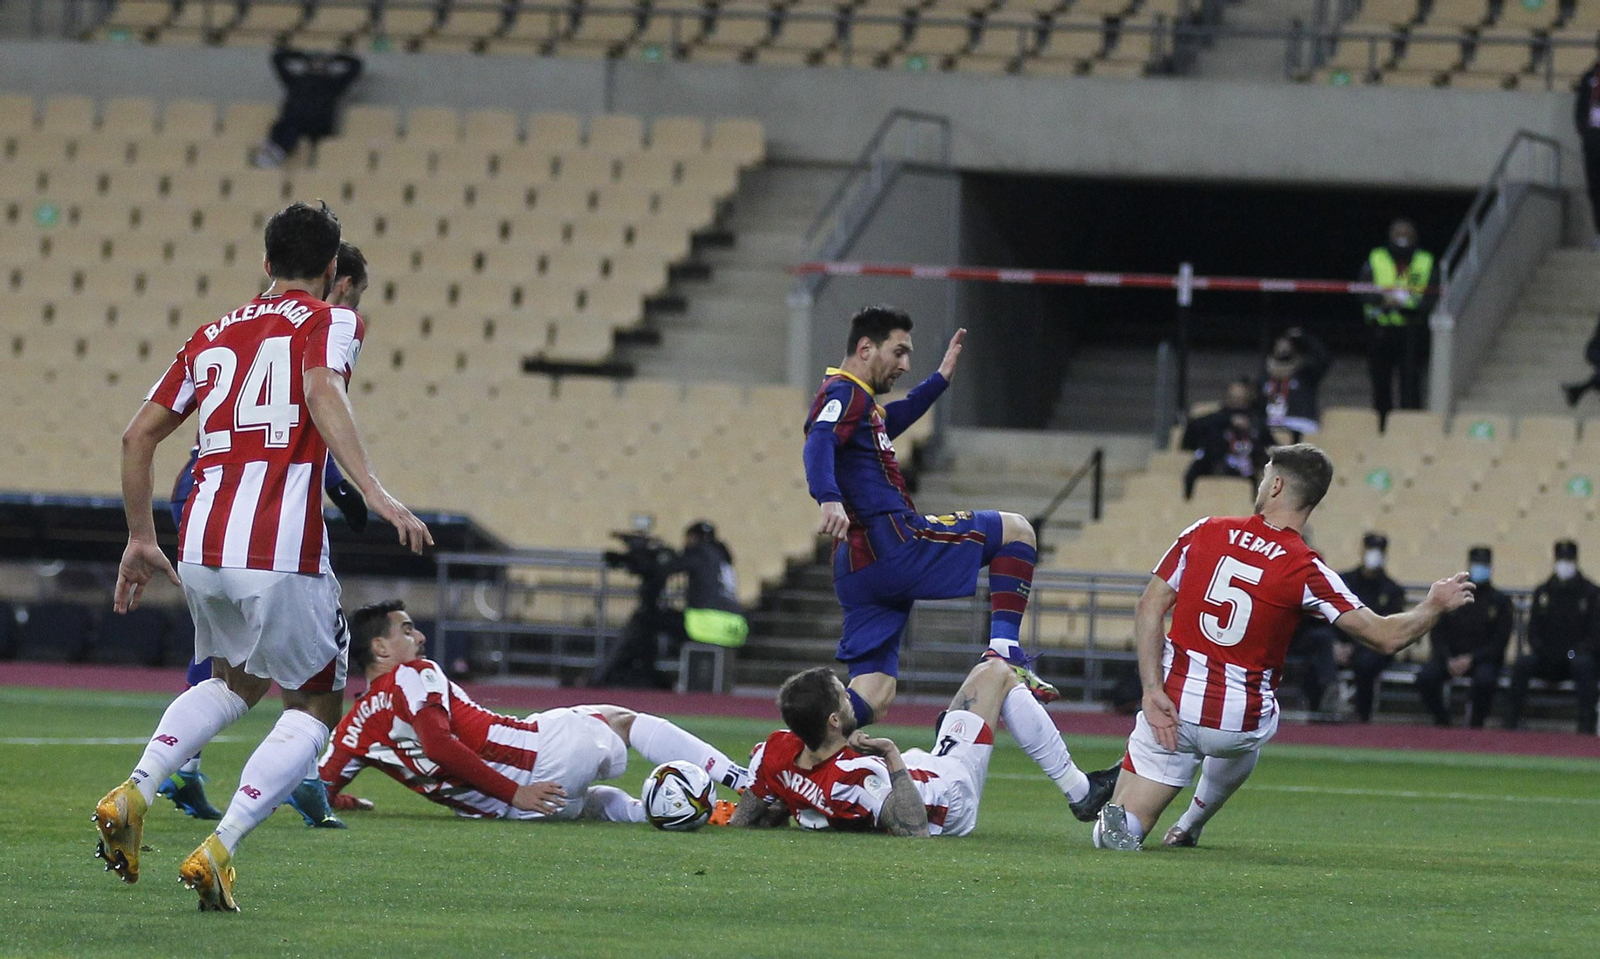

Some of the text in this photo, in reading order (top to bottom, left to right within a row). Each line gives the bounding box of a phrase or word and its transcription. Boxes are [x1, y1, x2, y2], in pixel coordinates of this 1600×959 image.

[193, 335, 299, 458] 24
[1228, 529, 1287, 560] YERAY
[1199, 555, 1264, 646] 5
[776, 769, 834, 816] RTINE
